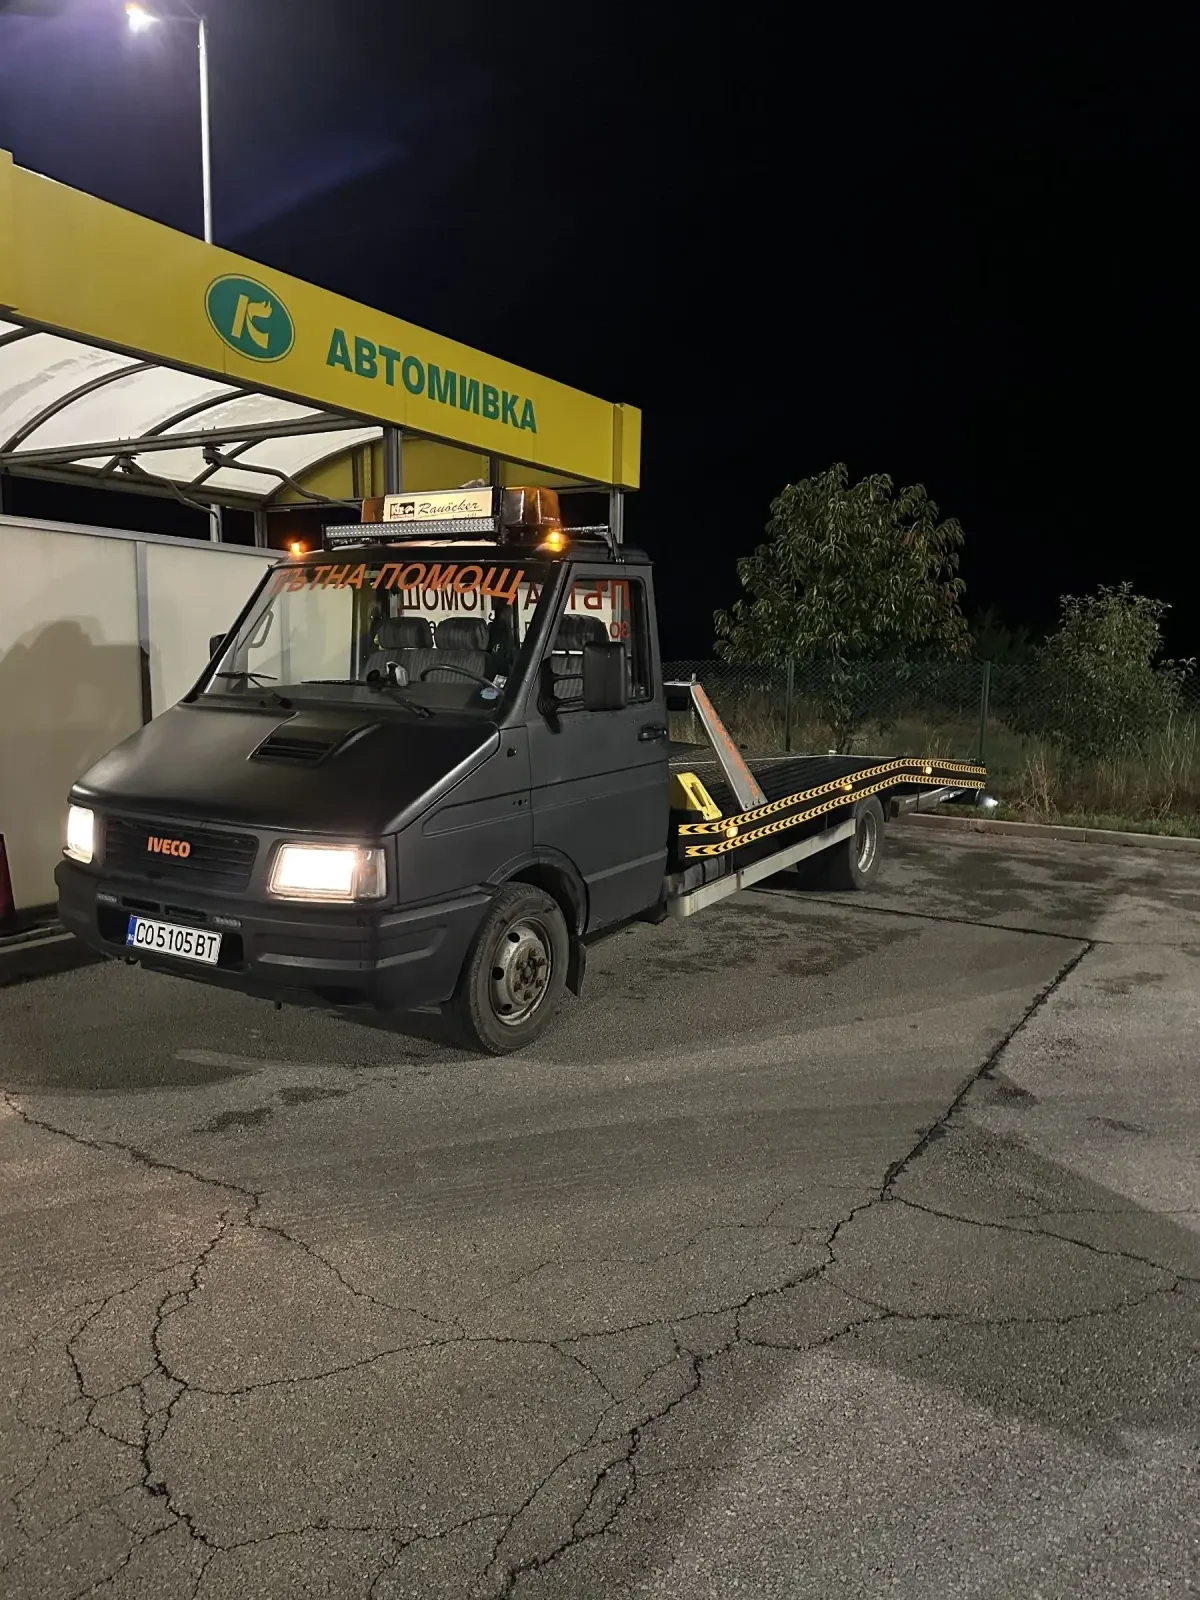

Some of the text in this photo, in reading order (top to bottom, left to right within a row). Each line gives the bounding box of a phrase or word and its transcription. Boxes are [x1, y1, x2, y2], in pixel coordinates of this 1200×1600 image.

[326, 328, 537, 434] АВТОМИВКА
[268, 563, 525, 605] ПЪТНА ПОМОЩ
[147, 836, 191, 858] IVECO
